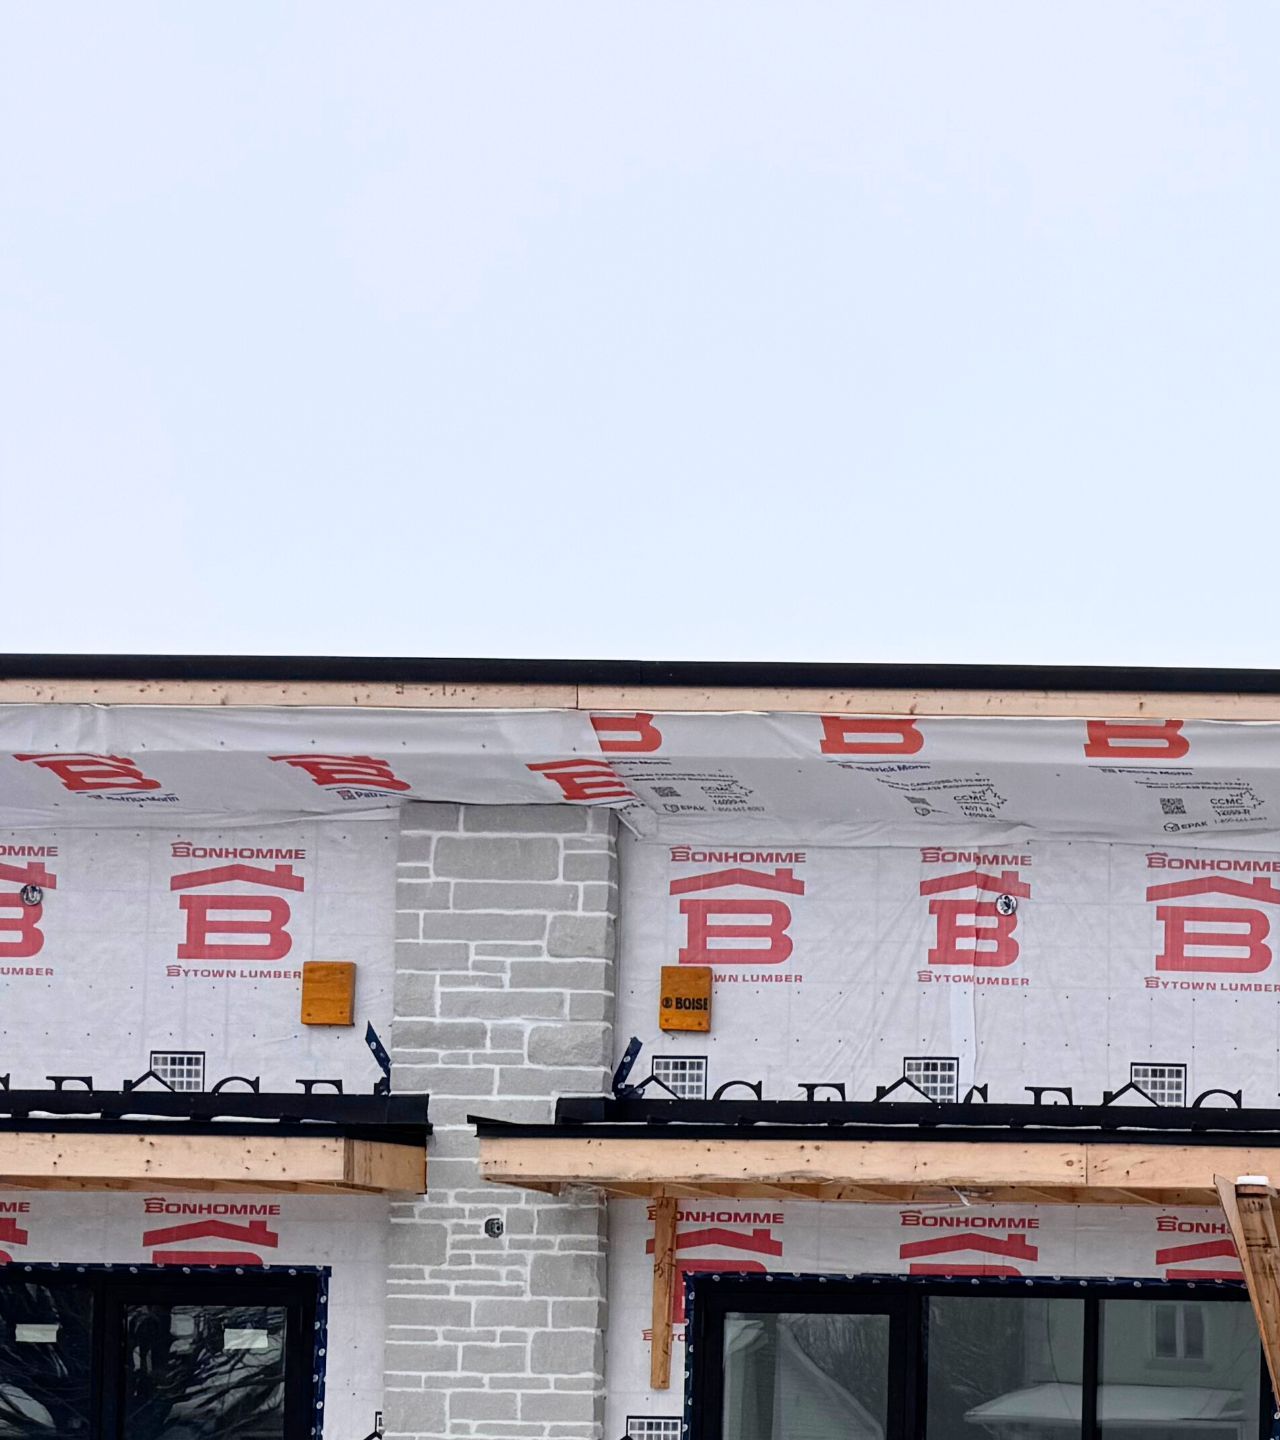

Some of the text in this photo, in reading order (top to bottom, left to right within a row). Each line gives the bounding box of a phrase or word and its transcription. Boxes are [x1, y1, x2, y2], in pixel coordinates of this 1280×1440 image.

[1181, 821, 1208, 830] EPAK
[170, 841, 307, 860] BONHOMME
[670, 845, 806, 863] BONHOMME
[177, 894, 293, 961] B
[679, 899, 794, 965] B
[928, 899, 1020, 967] B
[1155, 906, 1272, 973] B
[166, 964, 302, 979] BYTOWN LUMBER
[743, 974, 803, 983] LUMBER
[1144, 976, 1215, 991] BYTOWN
[143, 1197, 281, 1216] BONHOMME
[899, 1210, 1040, 1229] BONHOMME
